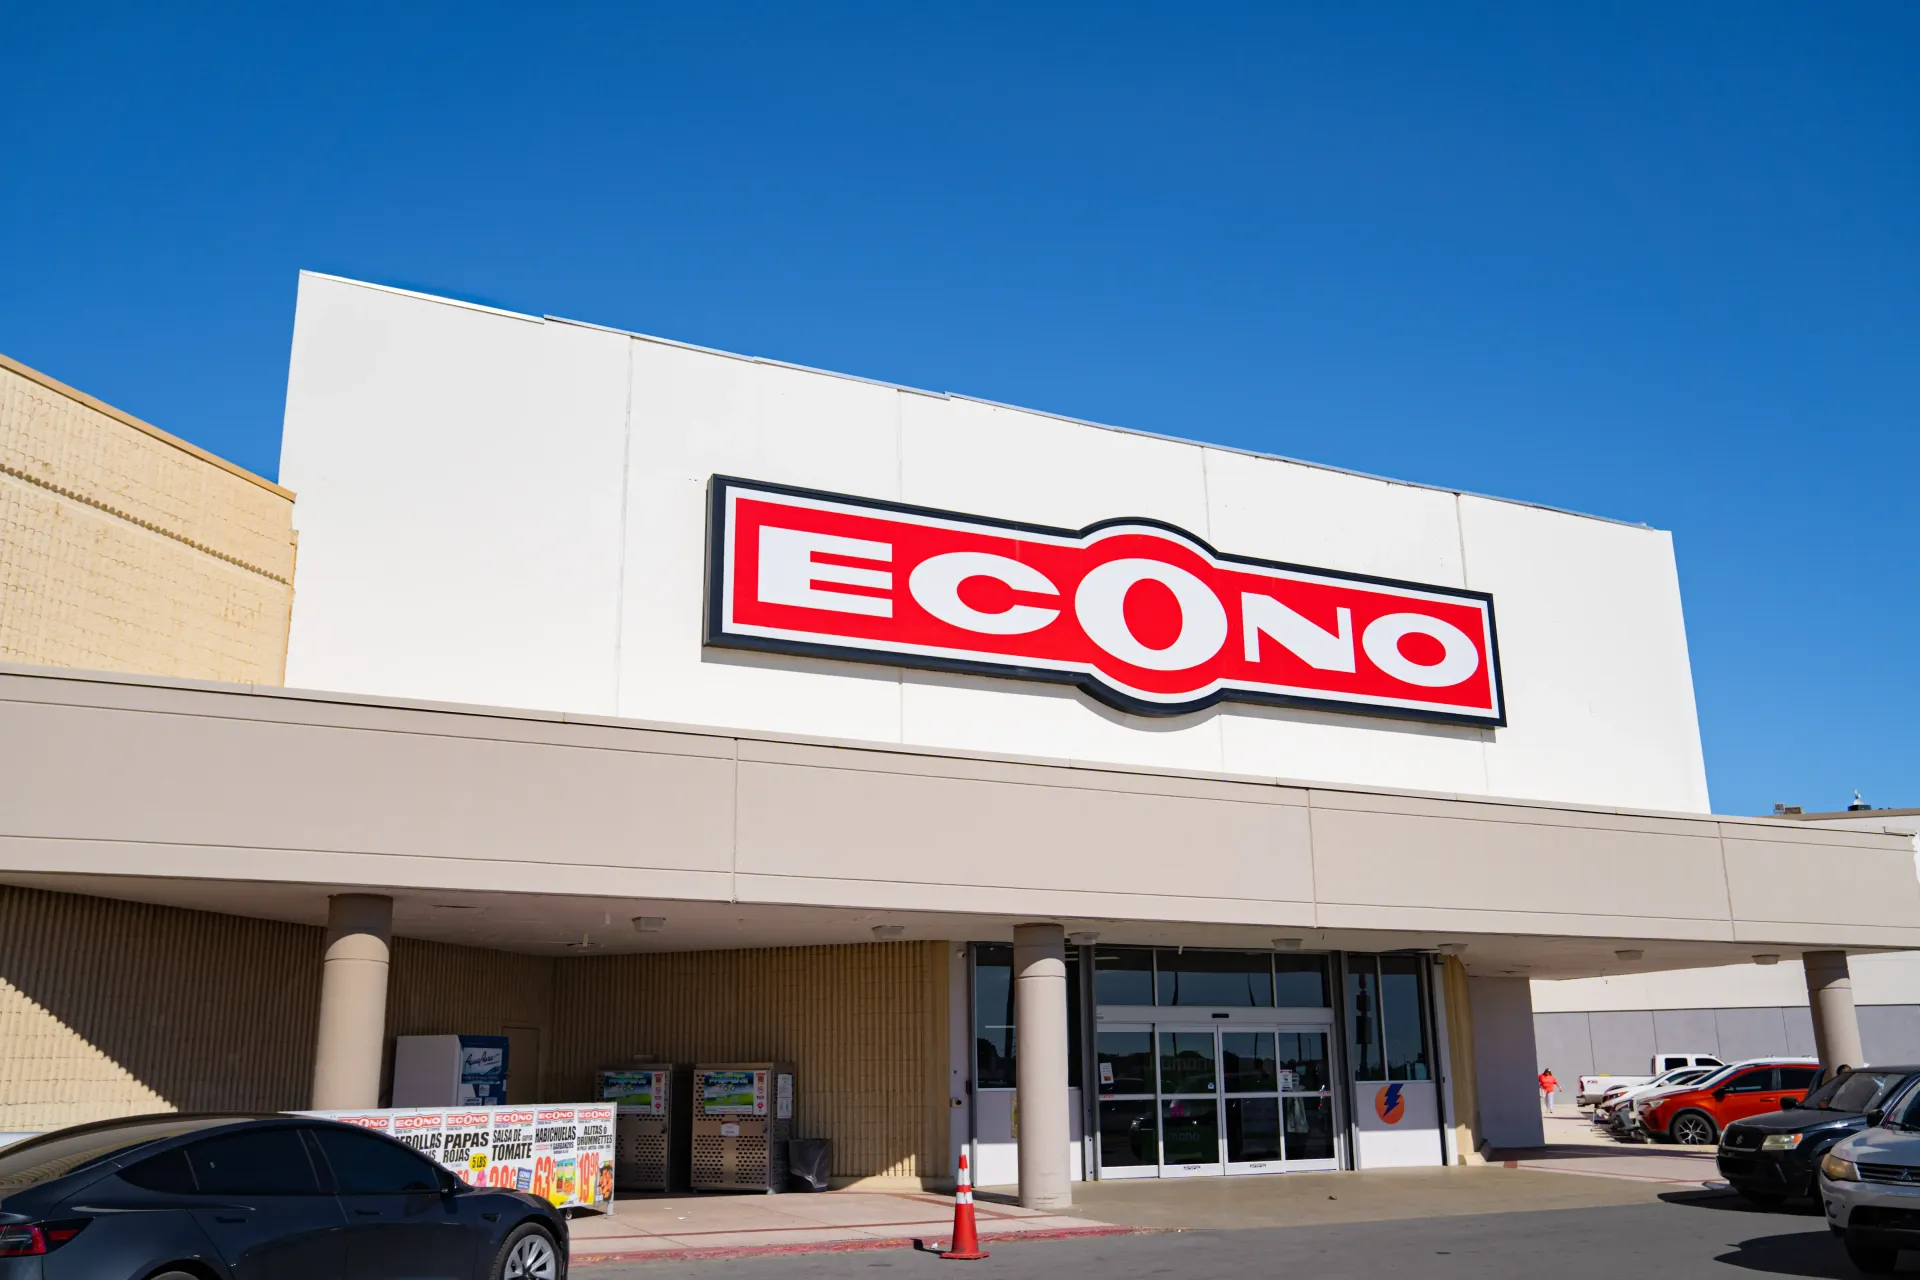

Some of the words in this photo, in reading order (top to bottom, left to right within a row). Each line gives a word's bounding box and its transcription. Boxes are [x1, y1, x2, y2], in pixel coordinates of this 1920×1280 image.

[757, 525, 1480, 688] ECONO
[447, 1115, 489, 1125] ECONO
[494, 1112, 533, 1123] ECONO
[538, 1111, 574, 1120] ECONO
[578, 1110, 612, 1119] ECONO
[394, 1116, 441, 1128] ECONO
[493, 1129, 512, 1143] SALSA
[513, 1128, 521, 1141] DE
[535, 1125, 577, 1143] HABICHUELAS
[584, 1125, 603, 1136] ALITAS
[396, 1132, 442, 1150] BOLLAS
[443, 1131, 490, 1149] PAPAS
[577, 1135, 612, 1146] DRUMMETTES
[443, 1148, 471, 1163] ROJAS
[492, 1143, 532, 1161] TOMATE
[472, 1157, 476, 1168] 5
[476, 1155, 487, 1168] LBS
